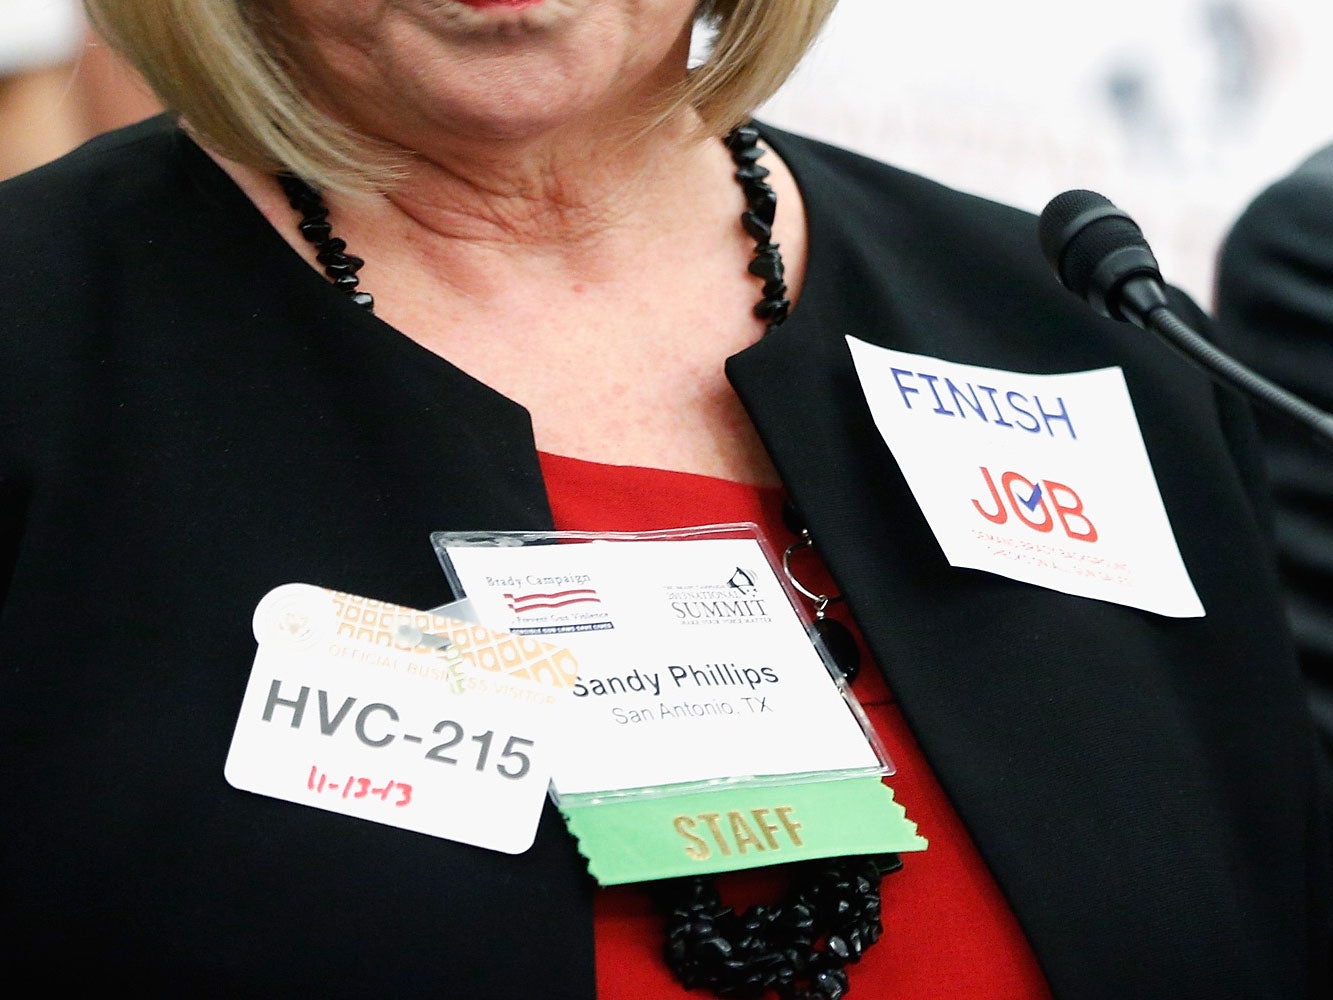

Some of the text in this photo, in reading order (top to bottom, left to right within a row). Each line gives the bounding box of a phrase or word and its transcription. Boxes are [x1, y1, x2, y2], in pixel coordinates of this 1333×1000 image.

[890, 367, 1077, 440] FINISH
[970, 466, 1098, 543] JOB
[486, 573, 591, 588] Brady Campaign
[671, 599, 767, 618] SUMMIT
[572, 663, 779, 698] Sandy Phillips
[262, 679, 535, 780] HVC-215
[611, 707, 655, 725] San
[741, 697, 774, 714] TX
[673, 806, 804, 860] STAFF
